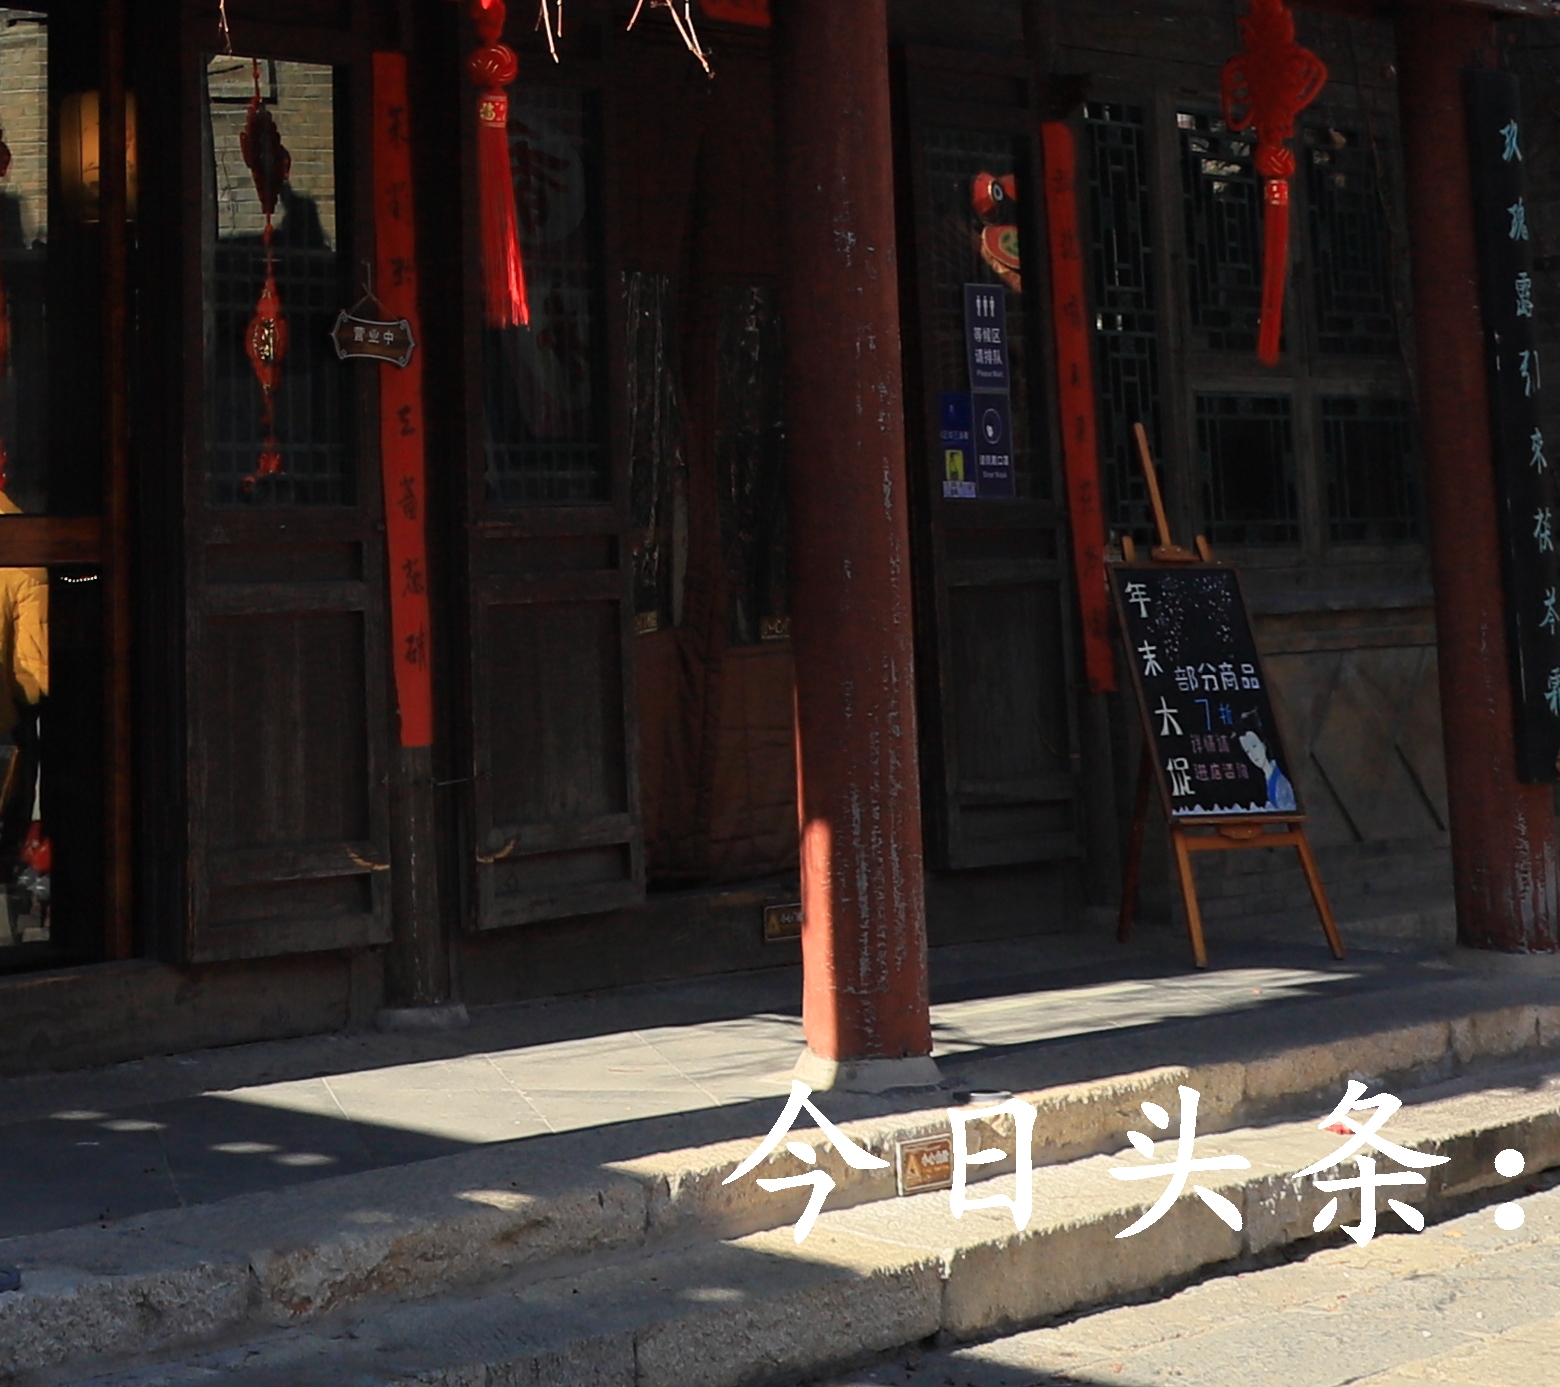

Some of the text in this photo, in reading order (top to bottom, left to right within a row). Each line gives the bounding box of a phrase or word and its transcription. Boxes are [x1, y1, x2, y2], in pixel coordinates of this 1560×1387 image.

[353, 325, 395, 346] 营业中
[973, 327, 1002, 344] 等候区
[974, 348, 1004, 365] 请排队
[1174, 661, 1260, 692] 部分商品
[1124, 581, 1196, 797] 年末大促
